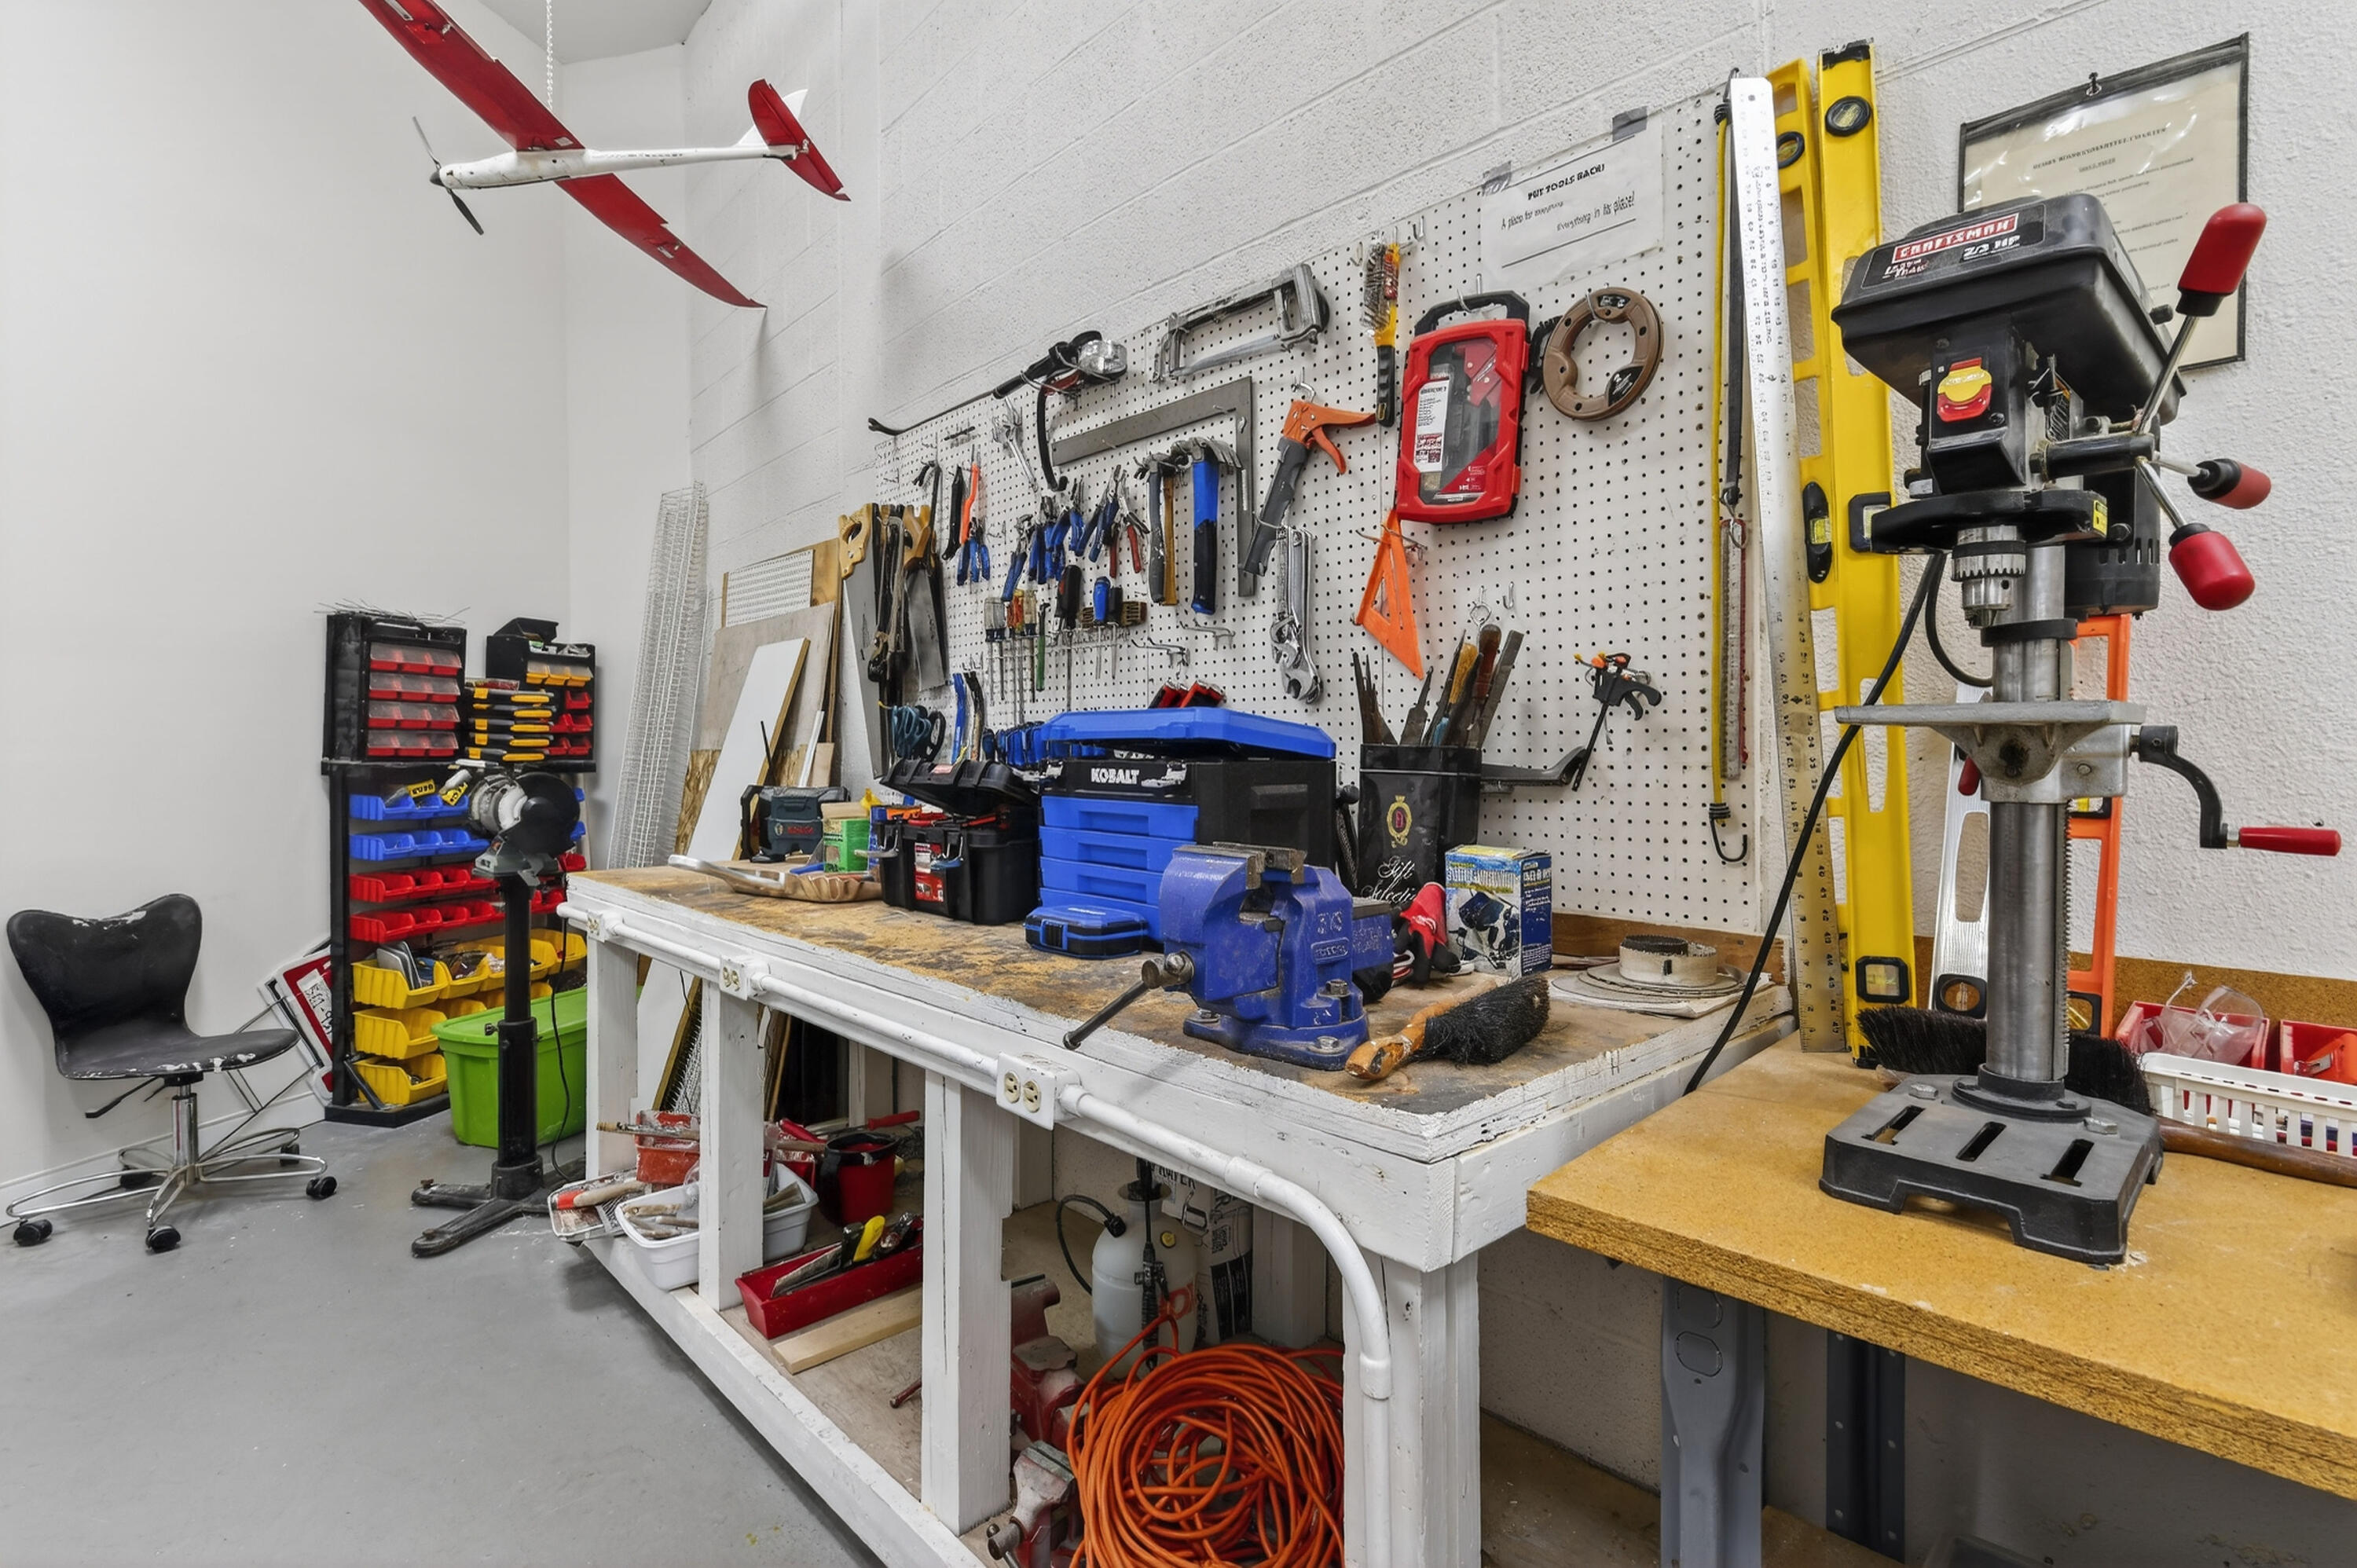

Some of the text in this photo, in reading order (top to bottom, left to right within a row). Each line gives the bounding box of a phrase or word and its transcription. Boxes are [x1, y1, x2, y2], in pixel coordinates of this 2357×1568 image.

[1527, 163, 1605, 200] PUT TOOLS BACK!
[1899, 219, 2011, 258] CRAFTSMAN
[1963, 235, 2020, 260] 2/3 HP
[1091, 768, 1139, 784] KOBALT
